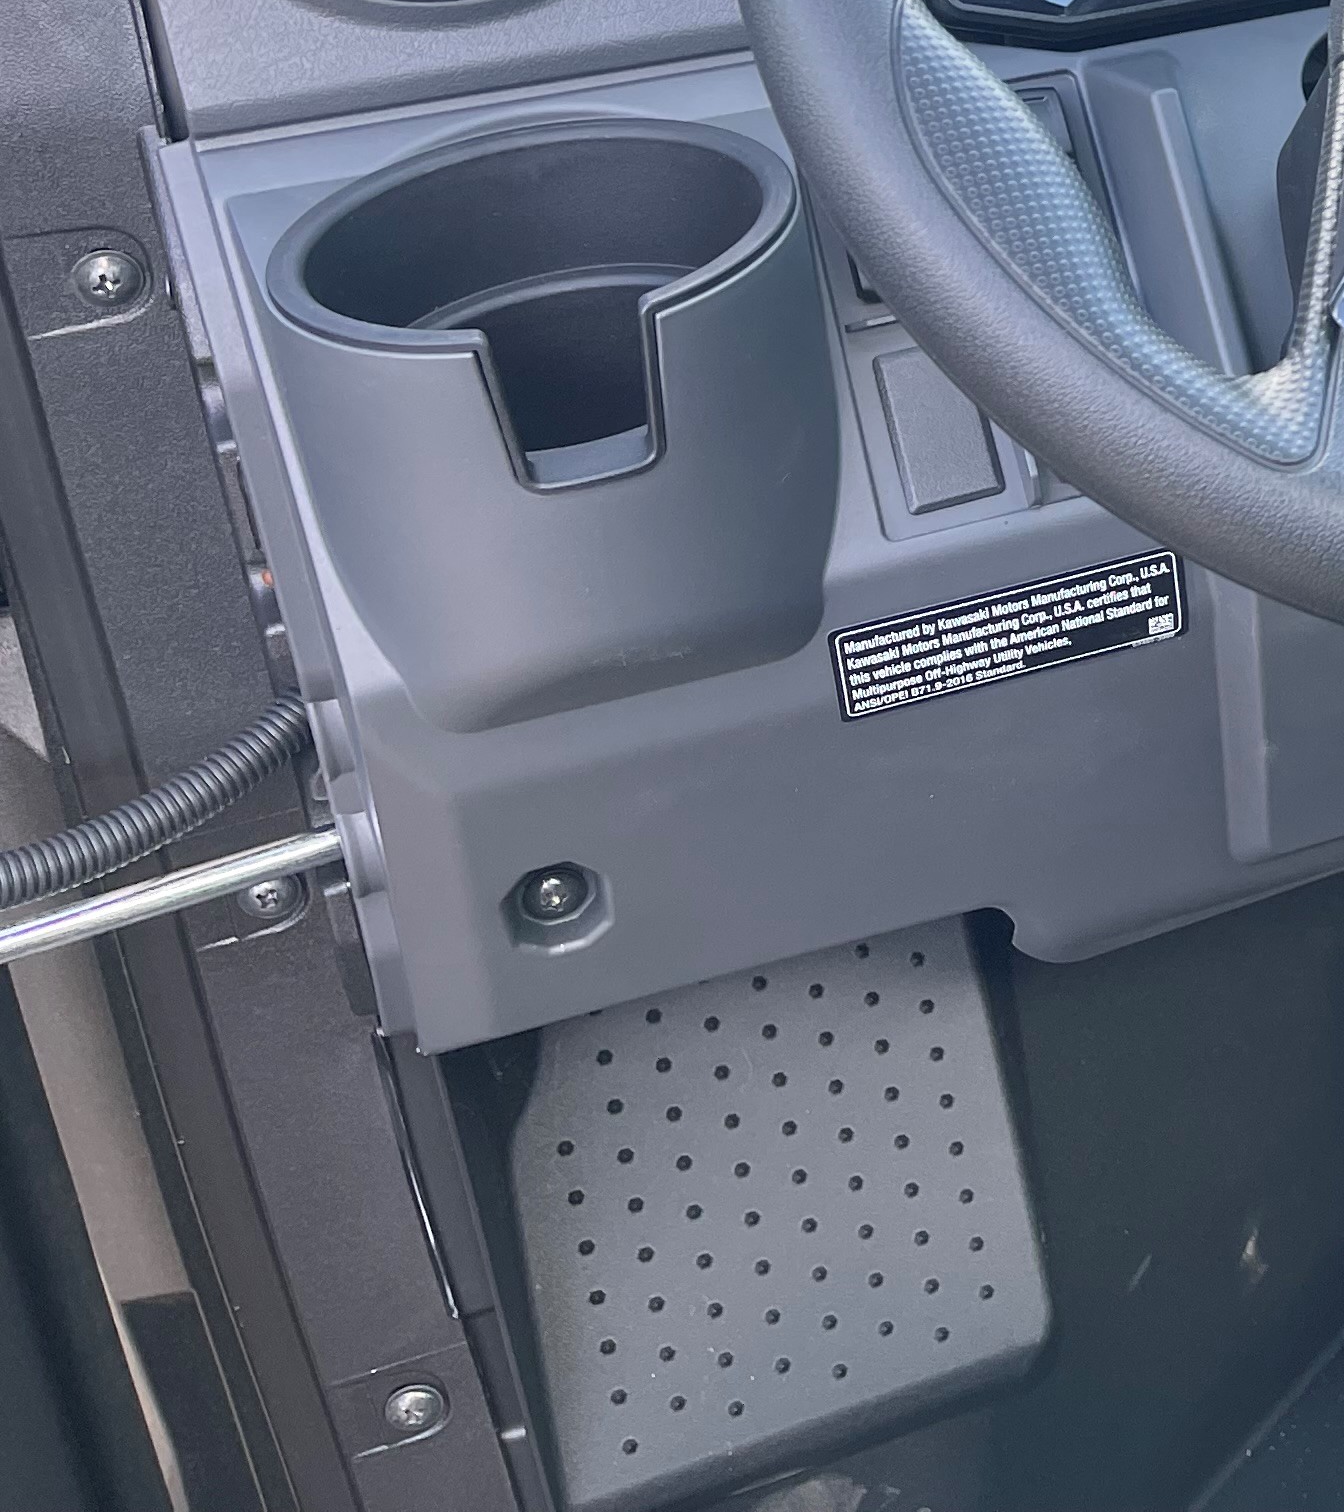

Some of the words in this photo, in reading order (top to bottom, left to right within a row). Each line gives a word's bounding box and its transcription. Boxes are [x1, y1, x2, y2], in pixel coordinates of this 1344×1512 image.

[844, 624, 920, 654] Manufactured
[922, 622, 936, 636] by
[937, 606, 990, 631] Kawasaki
[991, 598, 1030, 617] Motors
[1030, 578, 1107, 606] Manufacturing
[847, 646, 900, 670] Kawasaki
[901, 637, 941, 656] Motors
[941, 619, 1020, 646] Manufacturing
[1053, 599, 1085, 617] U.S.A.
[1086, 589, 1129, 609] certifies
[1129, 582, 1151, 598] that
[849, 671, 871, 687] this
[872, 661, 912, 681] vehicle
[913, 647, 963, 670] complies
[963, 640, 988, 657] with
[989, 635, 1008, 649] the
[1009, 622, 1060, 644] American
[1061, 610, 1104, 632] National
[1105, 596, 1153, 620] Standard
[1154, 595, 1170, 607] for
[852, 673, 923, 700] Multipurpose
[924, 654, 991, 681] Off-Highway
[993, 647, 1024, 664] Utility
[853, 691, 909, 713] ANSI/OPEI
[910, 675, 974, 697] B71.9-2016
[975, 658, 1026, 681] Standard.
